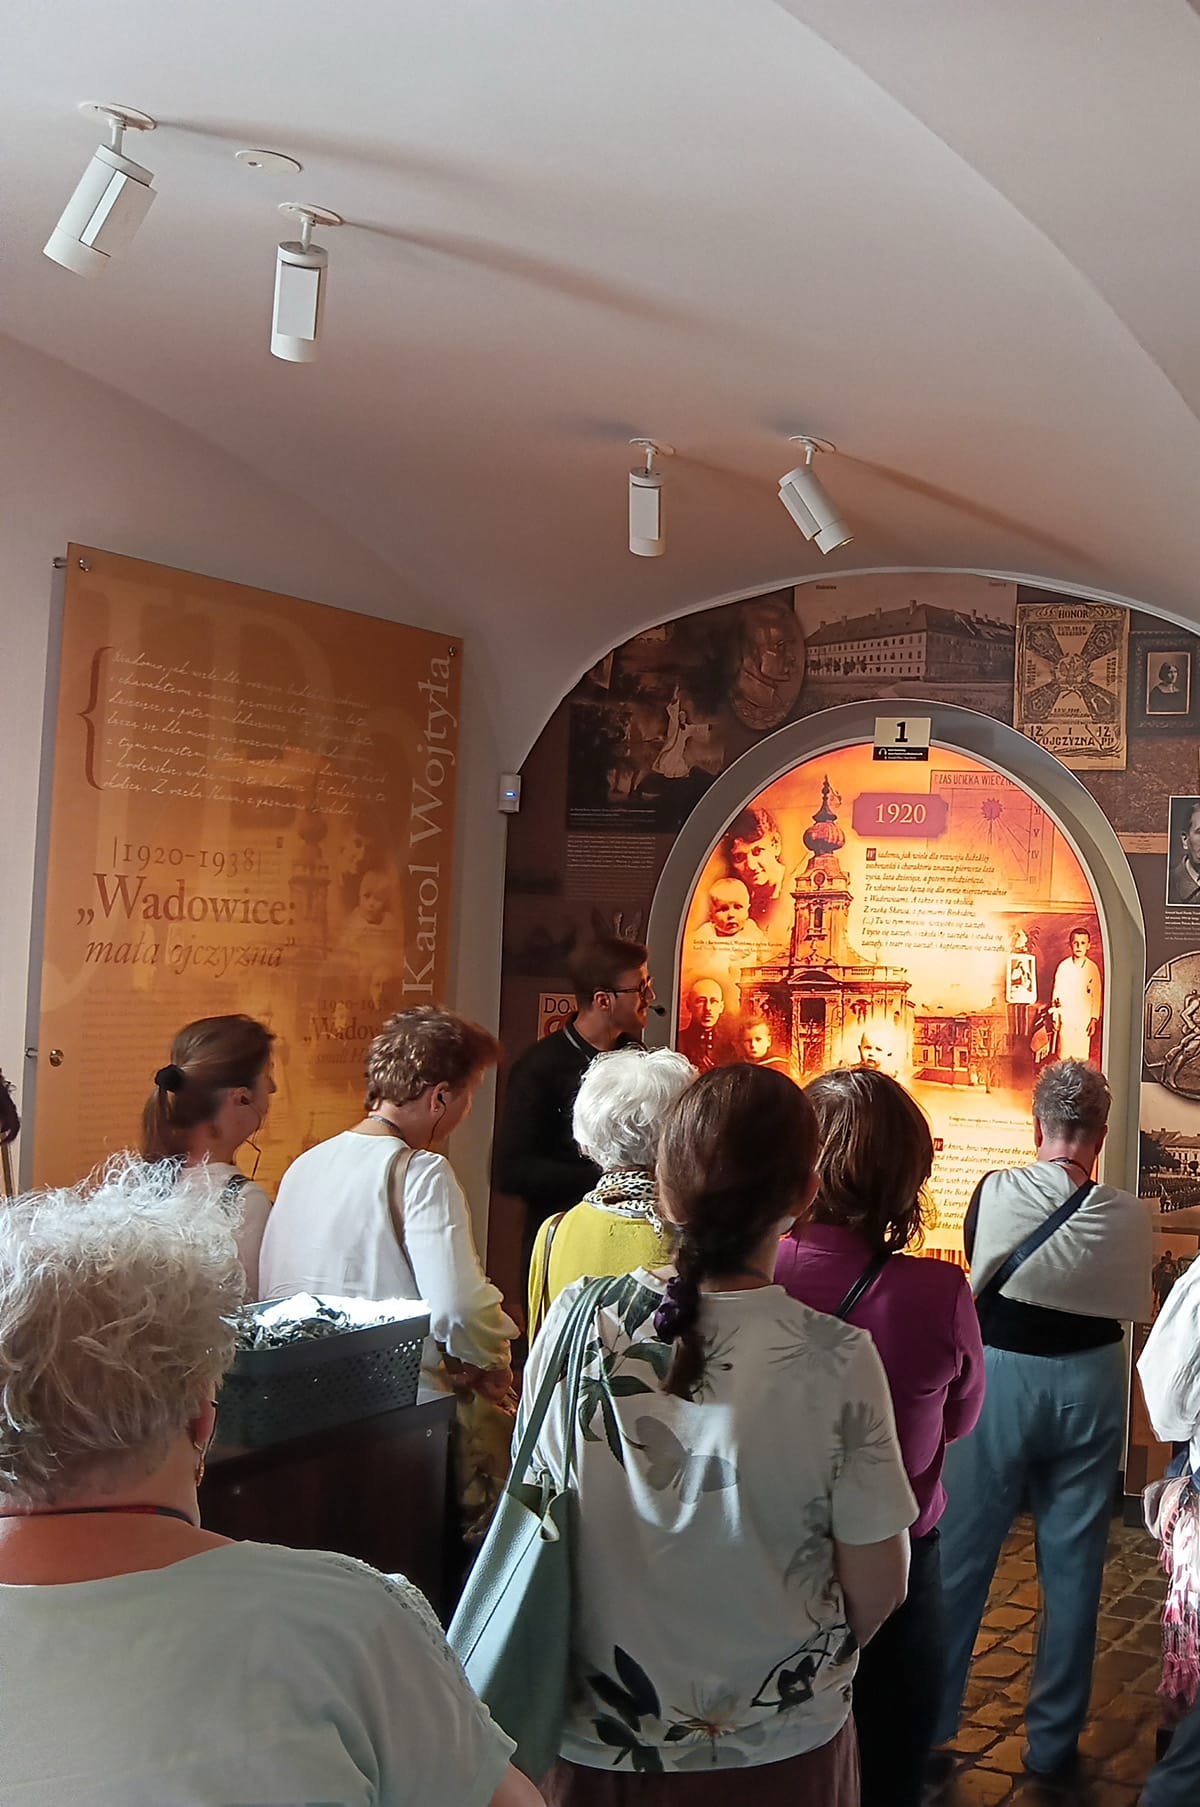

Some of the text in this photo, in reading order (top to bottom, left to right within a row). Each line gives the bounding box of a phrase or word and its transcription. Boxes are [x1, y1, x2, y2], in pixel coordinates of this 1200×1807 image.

[1058, 608, 1090, 619] HONOR
[894, 720, 909, 743] 1
[401, 651, 458, 996] Karol Wojtyła
[875, 802, 927, 825] 1920
[76, 872, 297, 926] „Wadowice:
[84, 931, 297, 978] mała ojczyzna”
[1144, 1003, 1174, 1040] 12
